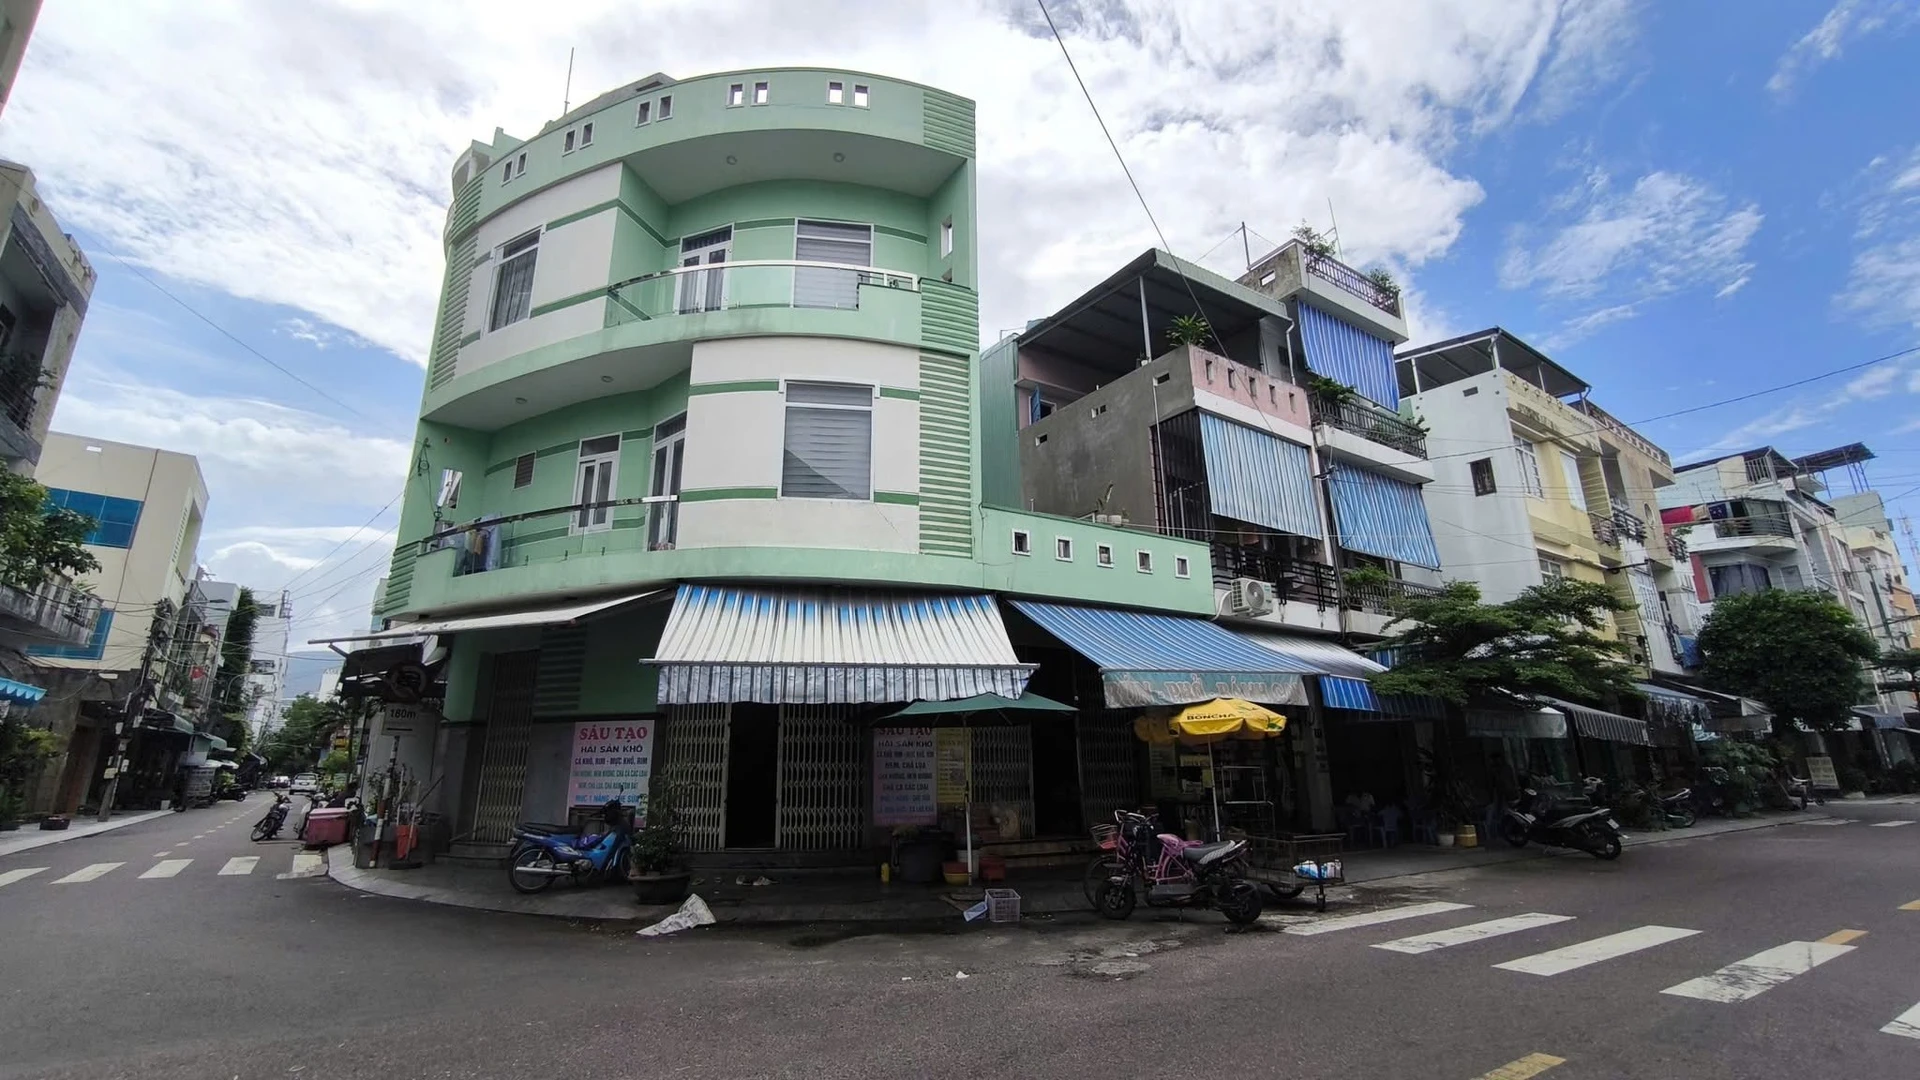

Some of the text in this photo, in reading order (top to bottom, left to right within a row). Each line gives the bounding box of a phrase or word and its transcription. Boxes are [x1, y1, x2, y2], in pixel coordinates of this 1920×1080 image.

[390, 708, 416, 719] 180m
[1187, 713, 1236, 721] BONCHA
[579, 724, 648, 743] SÁU TẠO
